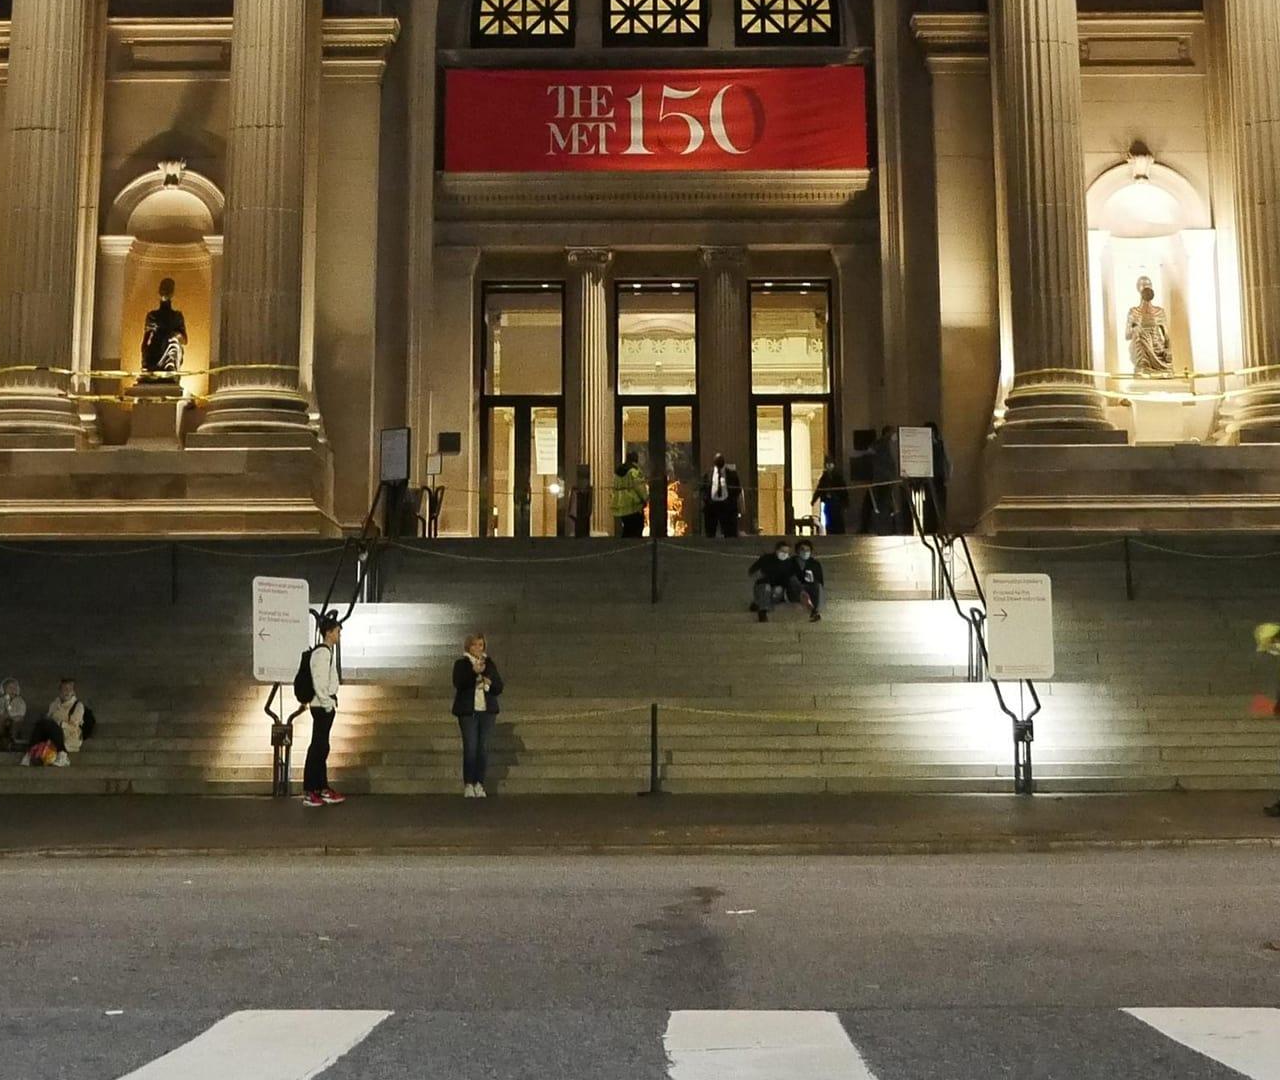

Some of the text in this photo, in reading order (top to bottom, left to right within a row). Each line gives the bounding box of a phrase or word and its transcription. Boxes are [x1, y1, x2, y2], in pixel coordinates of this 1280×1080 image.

[546, 85, 615, 118] THE
[621, 84, 767, 155] 150
[545, 122, 617, 155] MET
